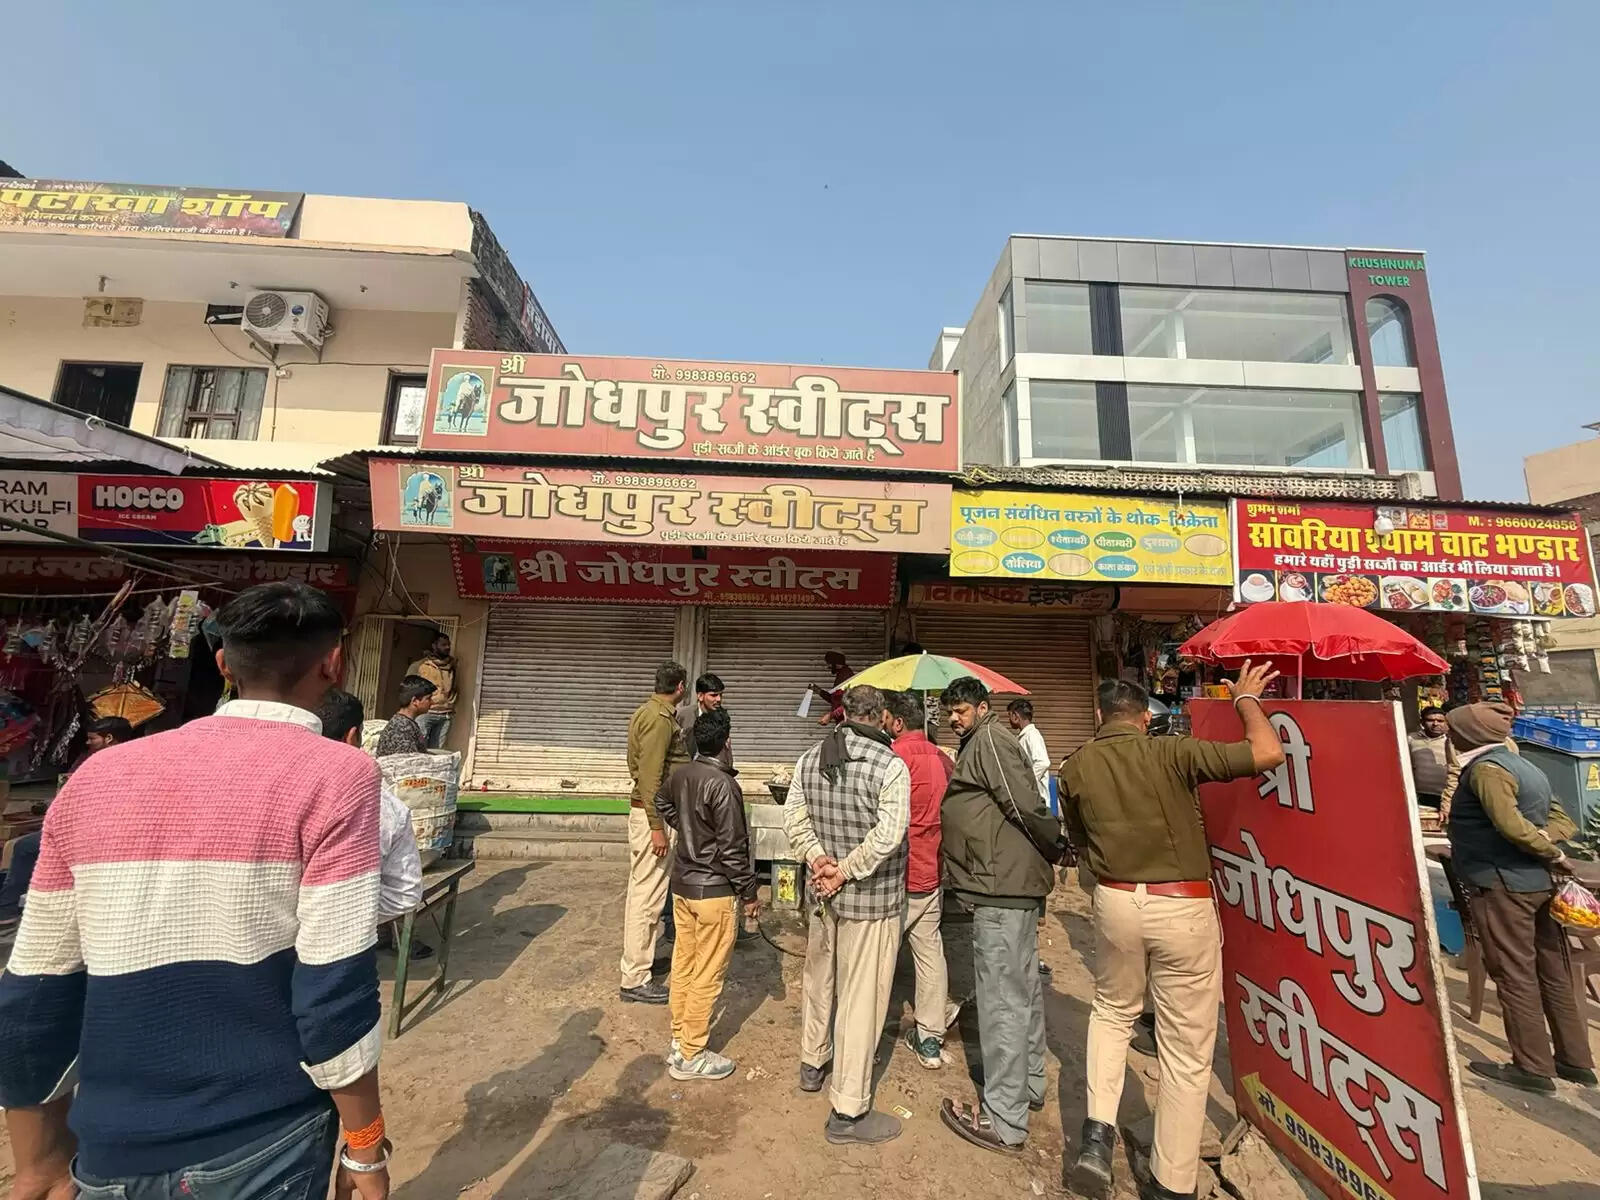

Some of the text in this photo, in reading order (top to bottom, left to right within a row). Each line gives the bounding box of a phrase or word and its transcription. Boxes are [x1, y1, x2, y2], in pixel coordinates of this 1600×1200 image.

[181, 193, 288, 218] शॉप
[1348, 256, 1425, 270] KHUSHNUMA
[1368, 275, 1410, 287] TOWER
[500, 355, 527, 374] श्री
[652, 364, 756, 384] मो. 9983896662
[499, 363, 951, 455] जोधपुर स्वीट्स
[748, 443, 759, 455] के
[816, 445, 839, 460] किये
[842, 448, 864, 461] जाते
[459, 465, 484, 479] श्री
[615, 475, 697, 488] 9983896662
[0, 479, 48, 496] RAM
[94, 484, 184, 512] HOCCO
[460, 472, 928, 543] जोधपुर स्वीट्स
[132, 513, 157, 521] CREAM
[960, 506, 1000, 524] पूजन
[1005, 503, 1061, 521] संबंधित
[1064, 506, 1102, 523] वस्त्रों
[1107, 507, 1122, 523] के
[1247, 503, 1301, 517] शुभम शर्मा
[1495, 518, 1578, 531] 9660024858
[1248, 517, 1580, 562] सांवरिया श्याम चाट भण्डार
[1274, 552, 1307, 567] हमारे
[1364, 557, 1398, 572] सब्जी
[1400, 559, 1418, 573] का
[1421, 559, 1456, 574] आर्डर
[1457, 560, 1474, 575] भी
[1475, 562, 1509, 576] लिया
[1511, 564, 1543, 577] जाता
[519, 551, 862, 599] श्री जोधपुर स्वीट्स
[1210, 829, 1425, 1016] जोधपुर
[1235, 970, 1449, 1194] स्वीट्स
[1257, 1090, 1387, 1200] मो. 9983896
